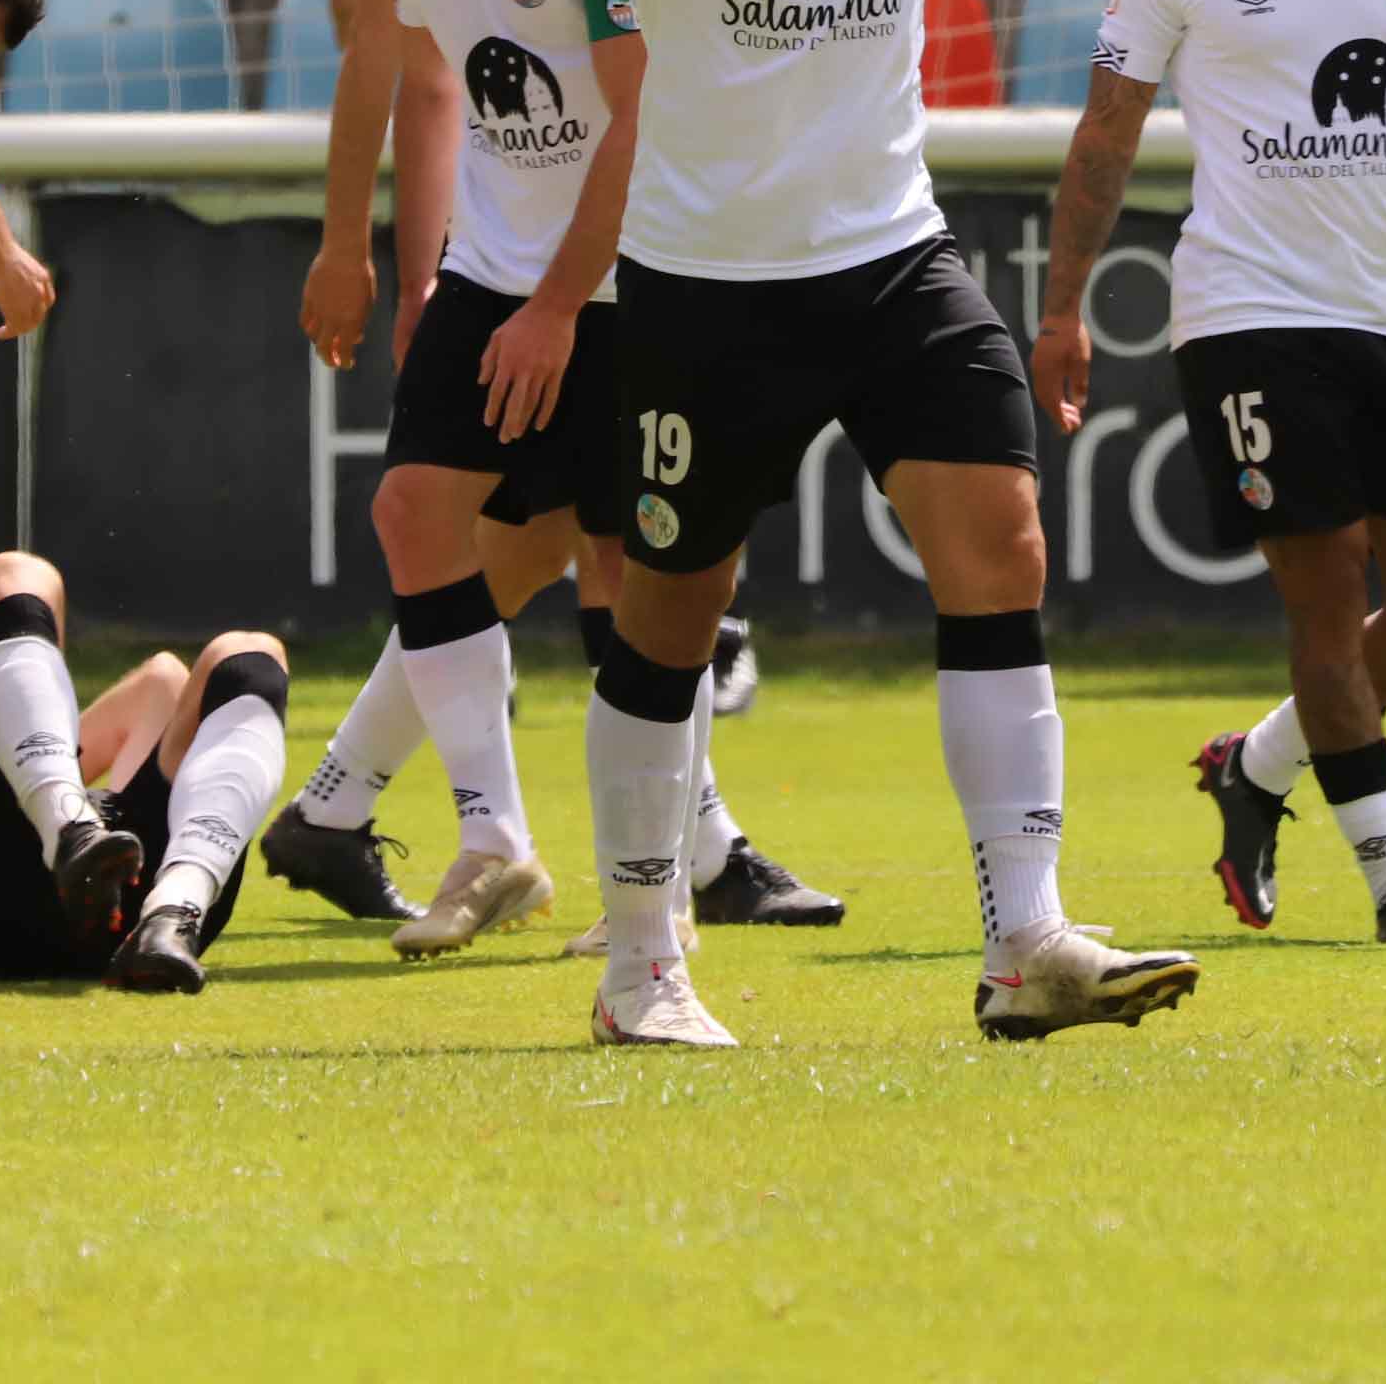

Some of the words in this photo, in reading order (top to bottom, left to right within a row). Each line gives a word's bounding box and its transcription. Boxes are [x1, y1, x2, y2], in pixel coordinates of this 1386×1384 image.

[733, 29, 806, 51] CIUDAD
[832, 22, 897, 41] TALENTO
[514, 147, 583, 169] TALENTO
[1256, 165, 1324, 180] CIUDAD
[1221, 391, 1272, 463] 15
[639, 409, 692, 486] 19
